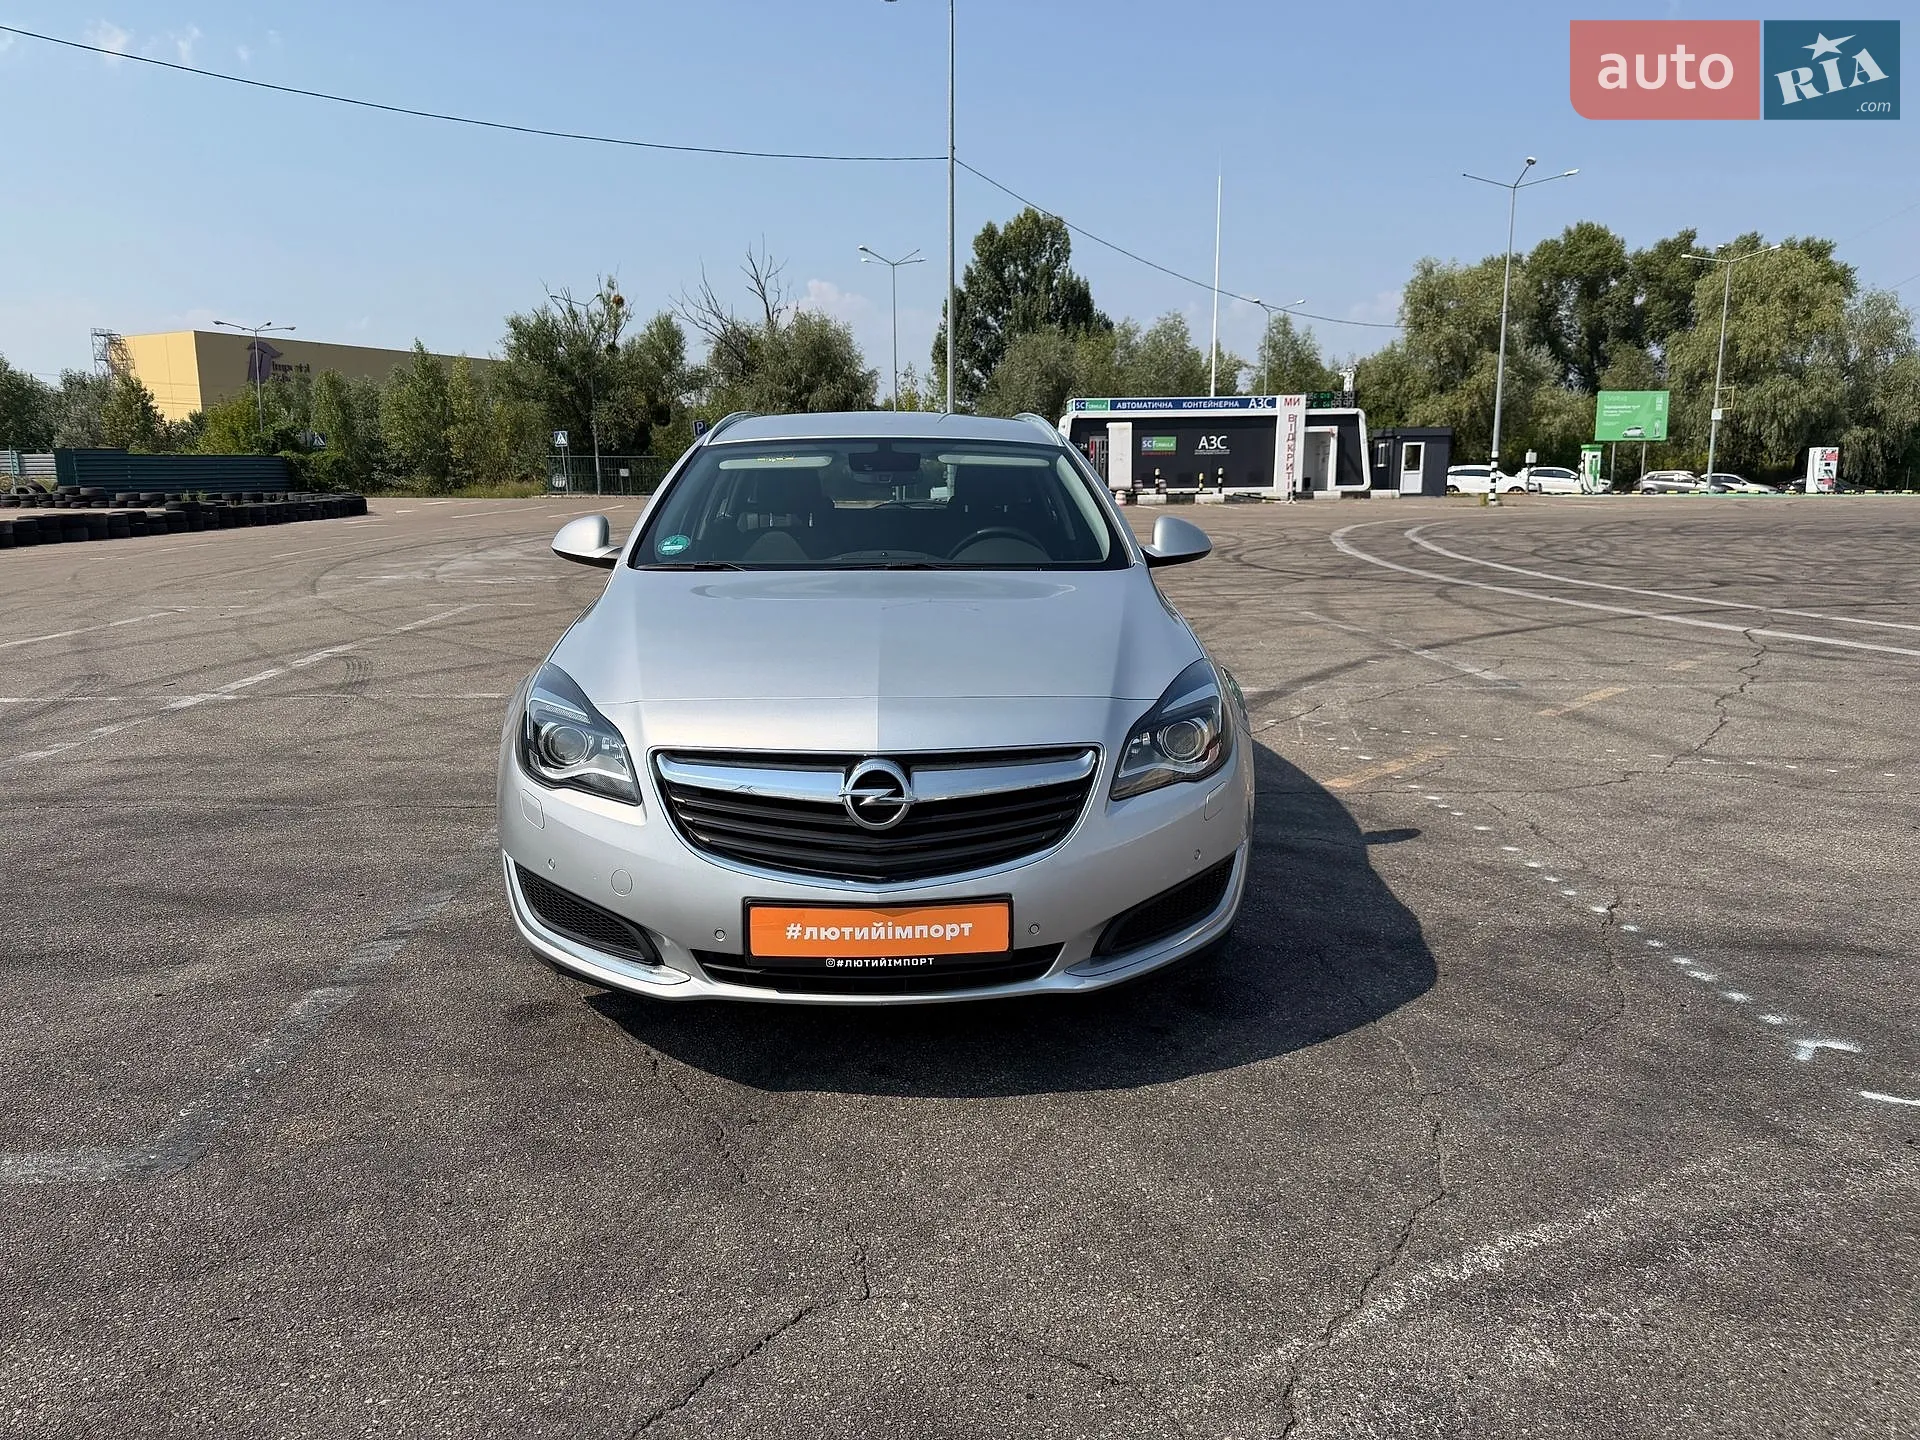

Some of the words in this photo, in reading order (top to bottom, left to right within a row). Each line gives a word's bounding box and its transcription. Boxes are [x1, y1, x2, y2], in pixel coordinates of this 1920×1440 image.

[1116, 400, 1173, 409] АВТОМАТИЧНА
[1182, 399, 1240, 409] КОНТЕЙНЕРНА
[1248, 397, 1273, 409] АЗС
[1283, 397, 1302, 407] МИ
[696, 421, 704, 434] P
[1198, 435, 1228, 450] АЗС
[1286, 413, 1296, 490] ВІДКРИТІ
[785, 921, 973, 941] #лютийімпорт
[836, 957, 935, 968] #ЛЮТИЙІМПОРТ
